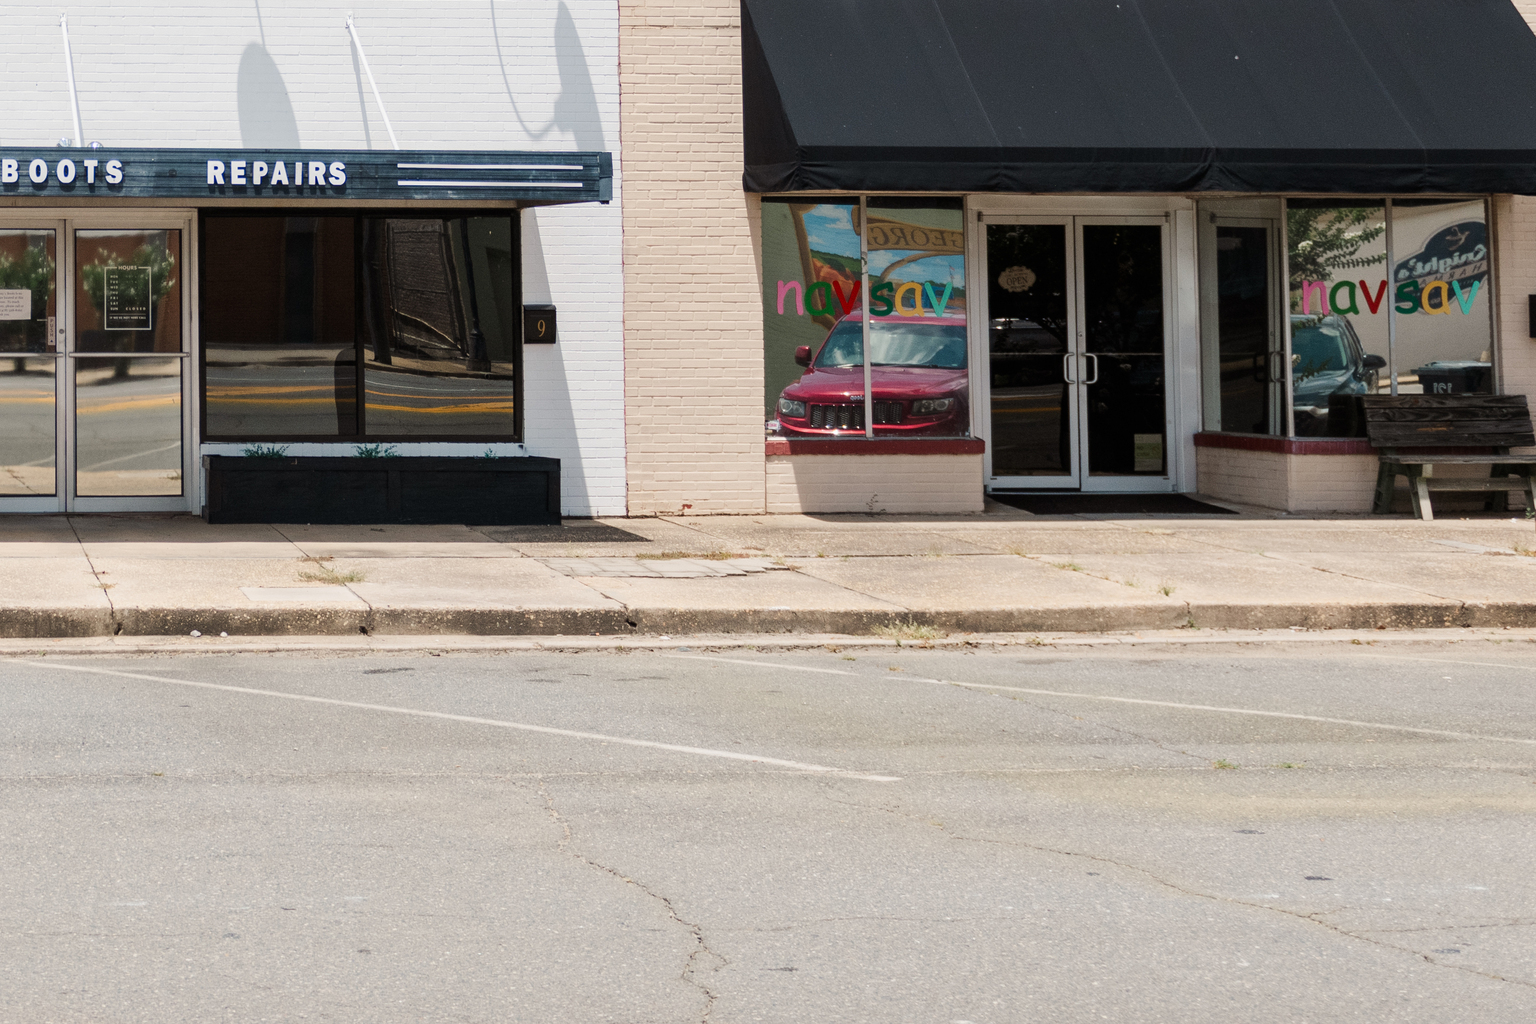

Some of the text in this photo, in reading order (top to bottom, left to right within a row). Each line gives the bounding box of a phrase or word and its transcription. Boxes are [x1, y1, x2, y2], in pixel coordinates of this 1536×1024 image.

[1, 158, 124, 184] BOOTS
[206, 160, 348, 186] REPAIRS
[1006, 275, 1028, 286] OPEN
[537, 319, 546, 338] 9
